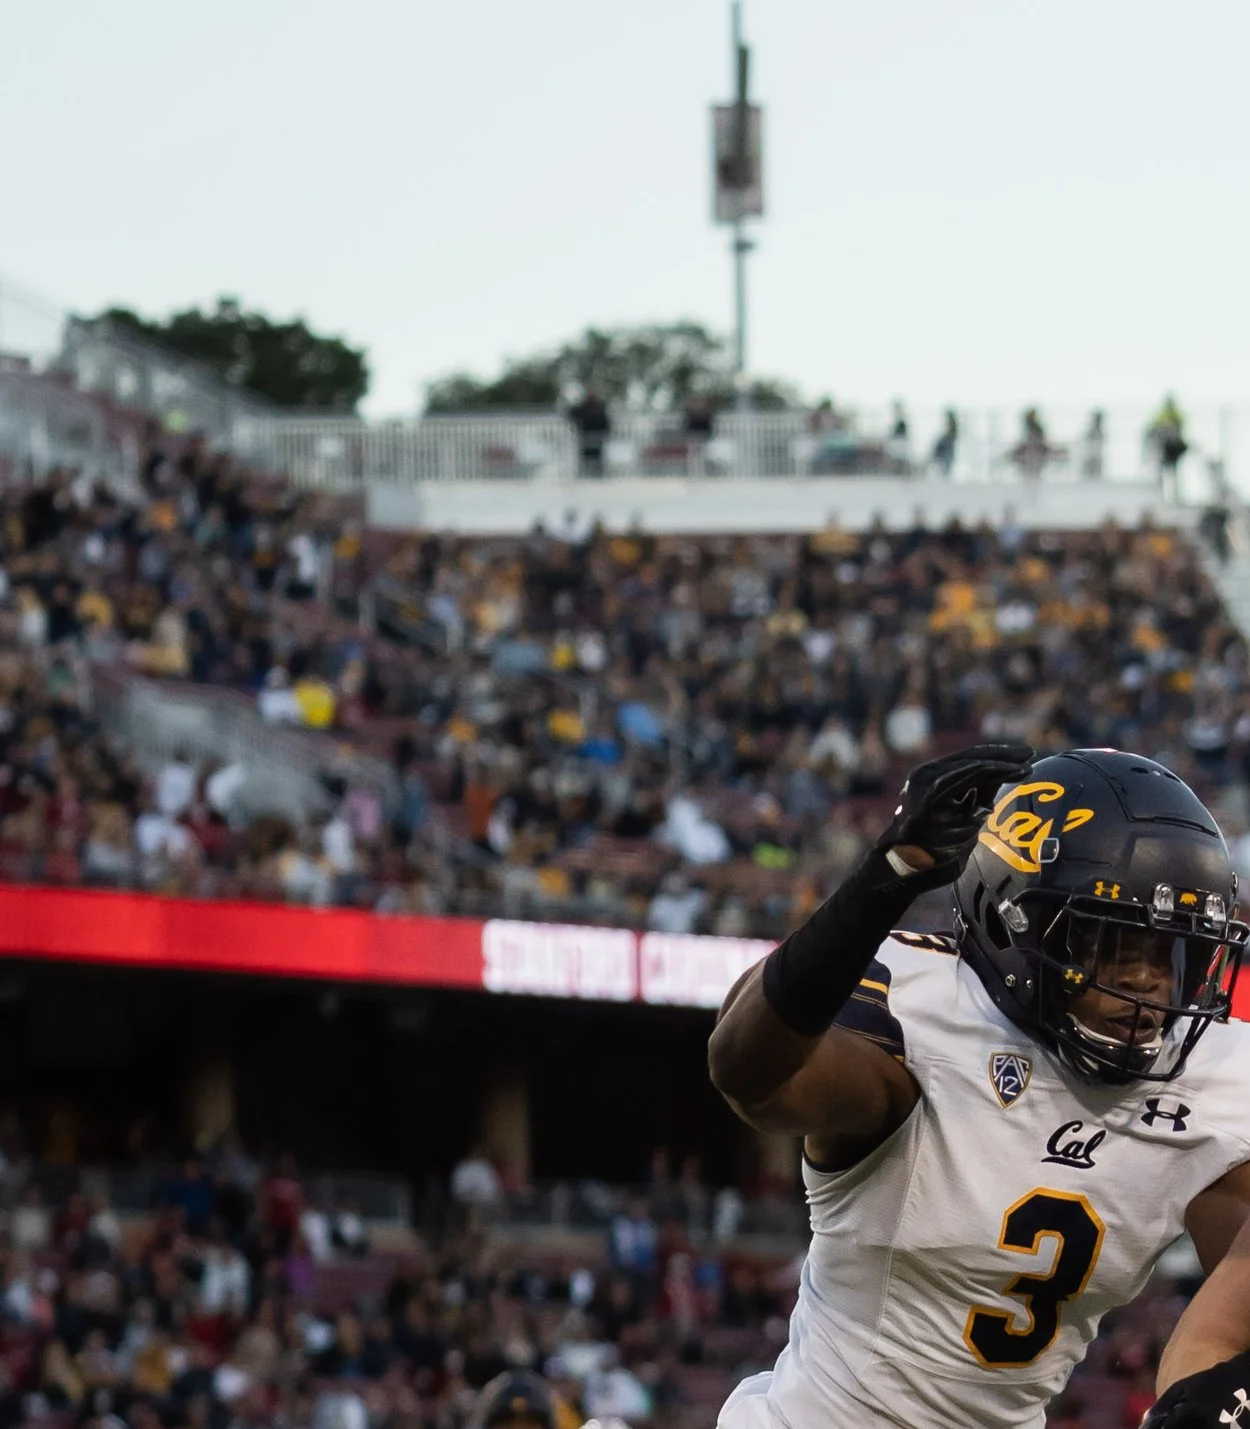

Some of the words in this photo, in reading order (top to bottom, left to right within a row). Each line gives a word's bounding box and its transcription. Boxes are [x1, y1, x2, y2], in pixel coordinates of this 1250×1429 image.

[979, 781, 1094, 872] Cal
[993, 1055, 1030, 1088] PAC
[999, 1075, 1019, 1096] 12
[1041, 1120, 1107, 1169] Cal
[963, 1187, 1107, 1369] 3
